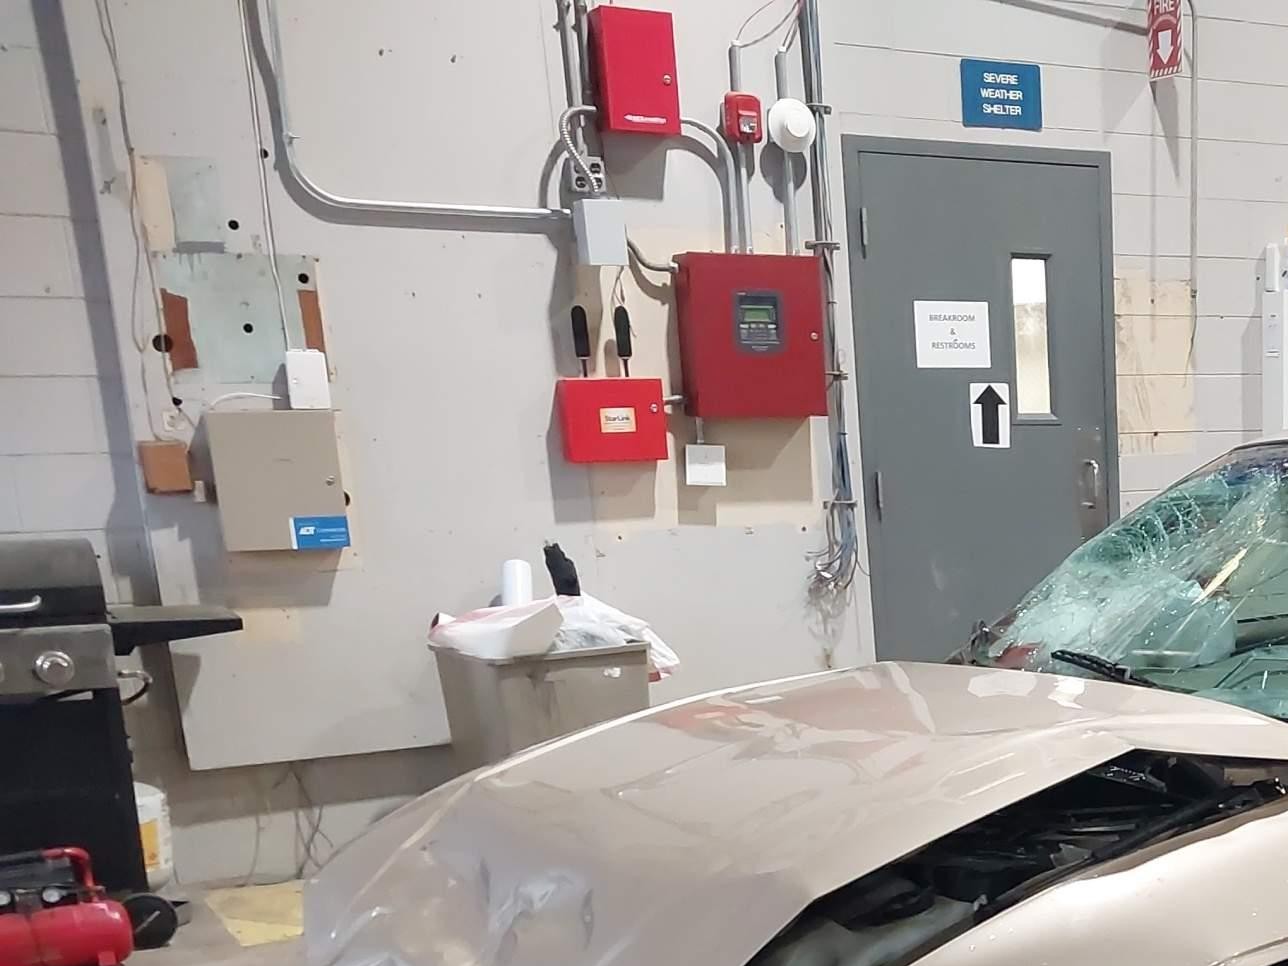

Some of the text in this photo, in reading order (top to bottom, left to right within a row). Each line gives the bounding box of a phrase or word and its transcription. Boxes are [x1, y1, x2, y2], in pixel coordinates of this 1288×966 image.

[1154, 0, 1176, 15] FIRE
[983, 72, 1019, 85] SEVERE
[980, 87, 1023, 101] WEATHER
[982, 103, 1022, 116] SHELTER
[928, 314, 976, 322] BREAKROOM
[949, 327, 957, 336] &
[931, 341, 976, 350] RESTROOMS
